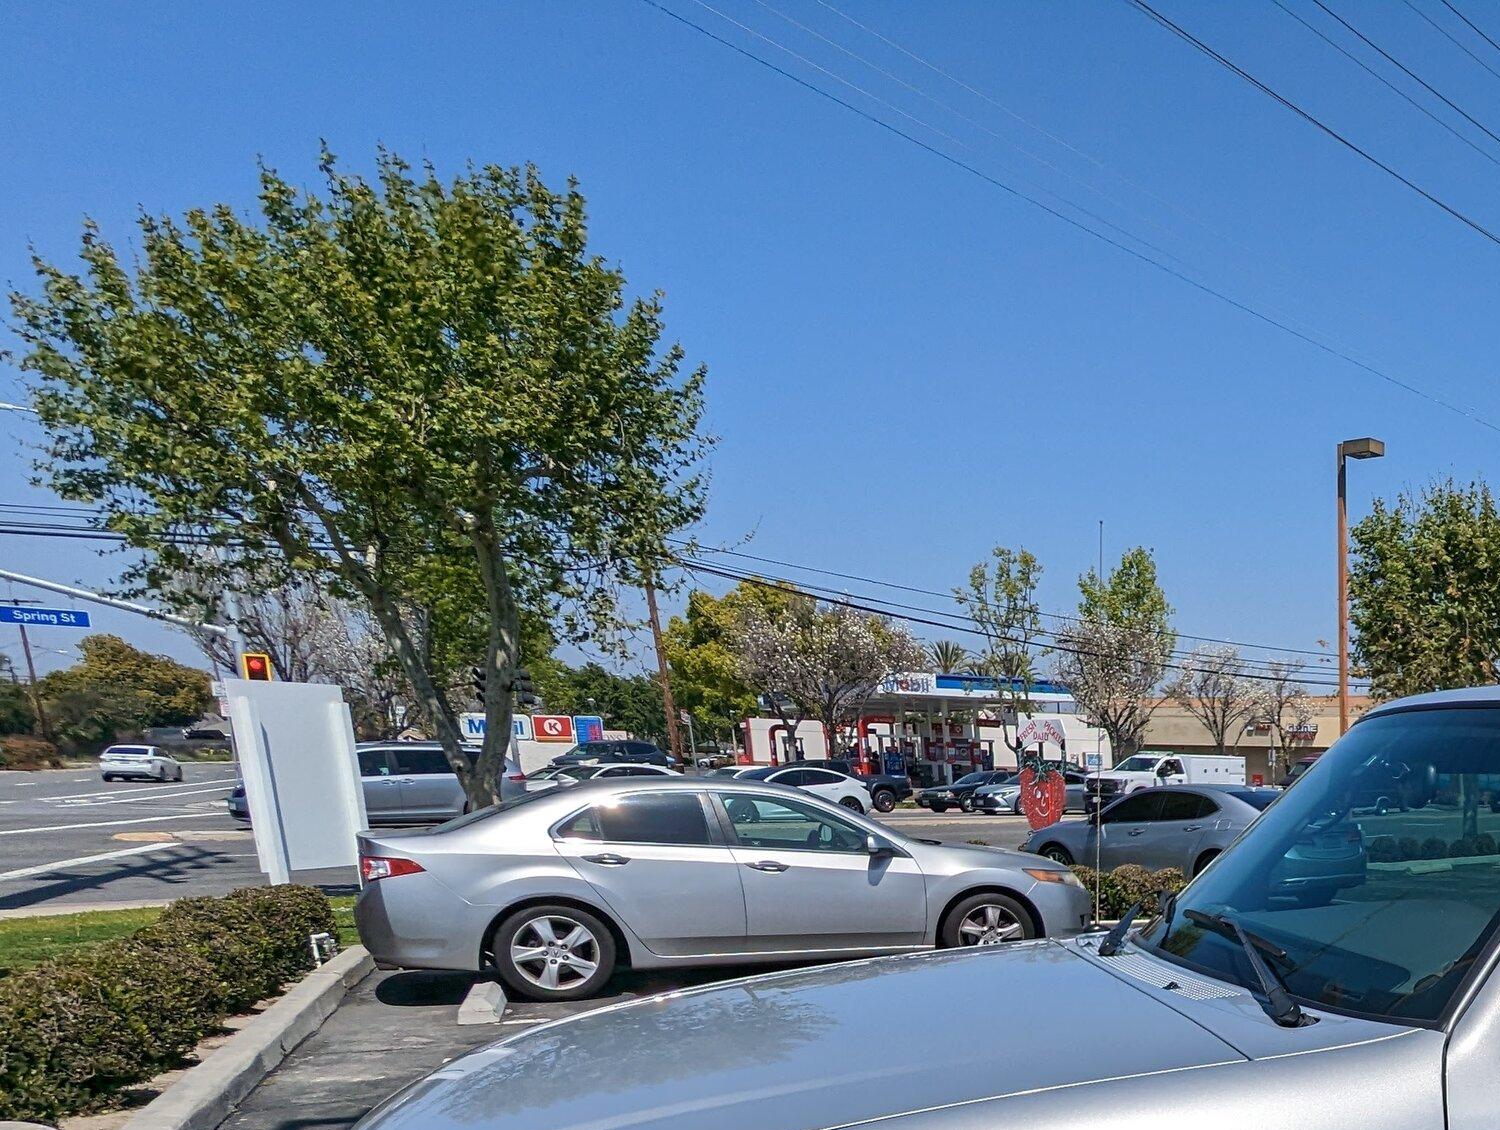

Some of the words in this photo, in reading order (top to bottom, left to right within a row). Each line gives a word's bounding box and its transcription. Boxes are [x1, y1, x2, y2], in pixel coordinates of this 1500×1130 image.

[12, 609, 58, 624] Spring
[60, 612, 76, 623] St
[467, 718, 524, 736] Mil
[549, 722, 562, 733] K
[1019, 720, 1037, 741] FRESH
